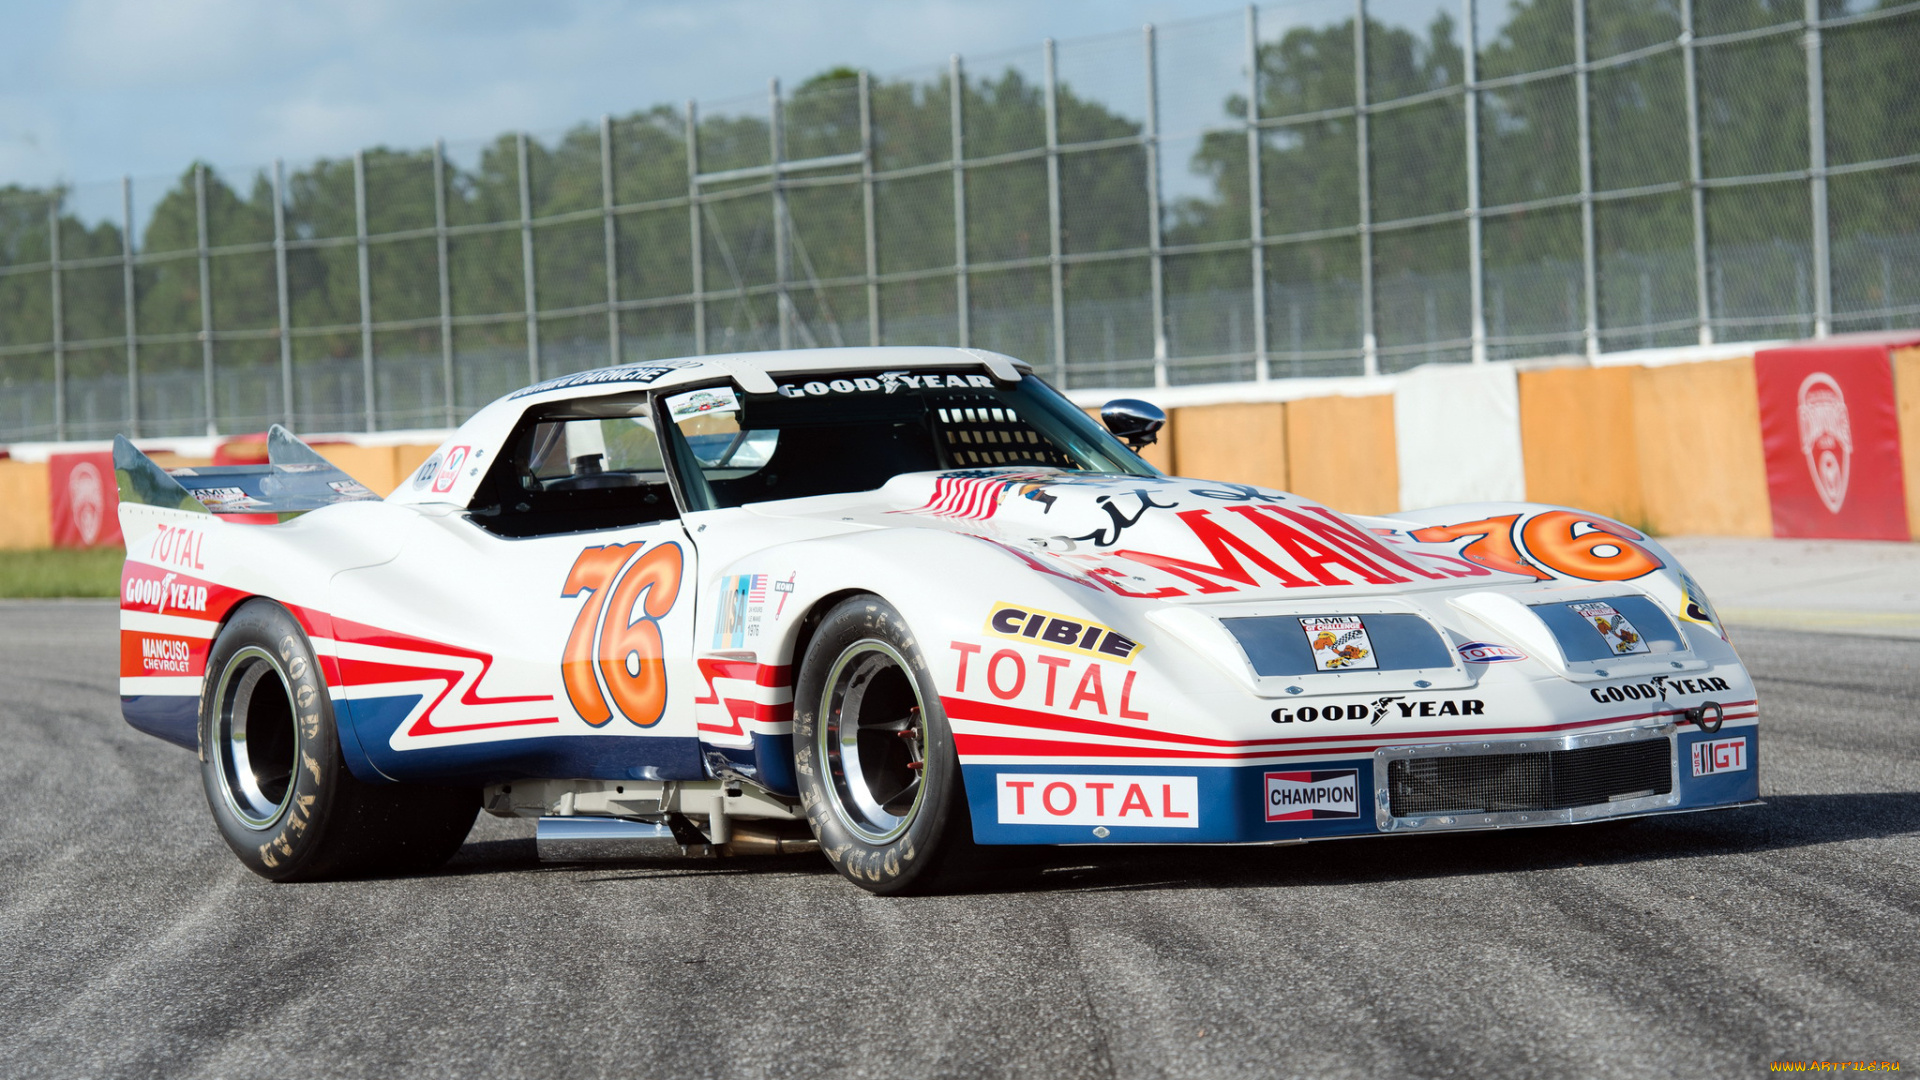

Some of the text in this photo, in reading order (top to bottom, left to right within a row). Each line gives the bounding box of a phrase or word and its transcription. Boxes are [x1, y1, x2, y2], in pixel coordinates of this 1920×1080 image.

[151, 524, 205, 570] TOTAL
[1406, 510, 1667, 583] 76
[560, 541, 684, 729] 76
[1302, 616, 1361, 626] CAMEL
[142, 638, 190, 661] MANCUSO
[1461, 646, 1523, 662] TOTAL
[143, 658, 190, 672] CHEVROLET
[950, 640, 1150, 722] TOTAL
[1714, 741, 1745, 769] GT
[1006, 781, 1189, 819] TOTAL
[1270, 786, 1354, 807] CHAMPION
